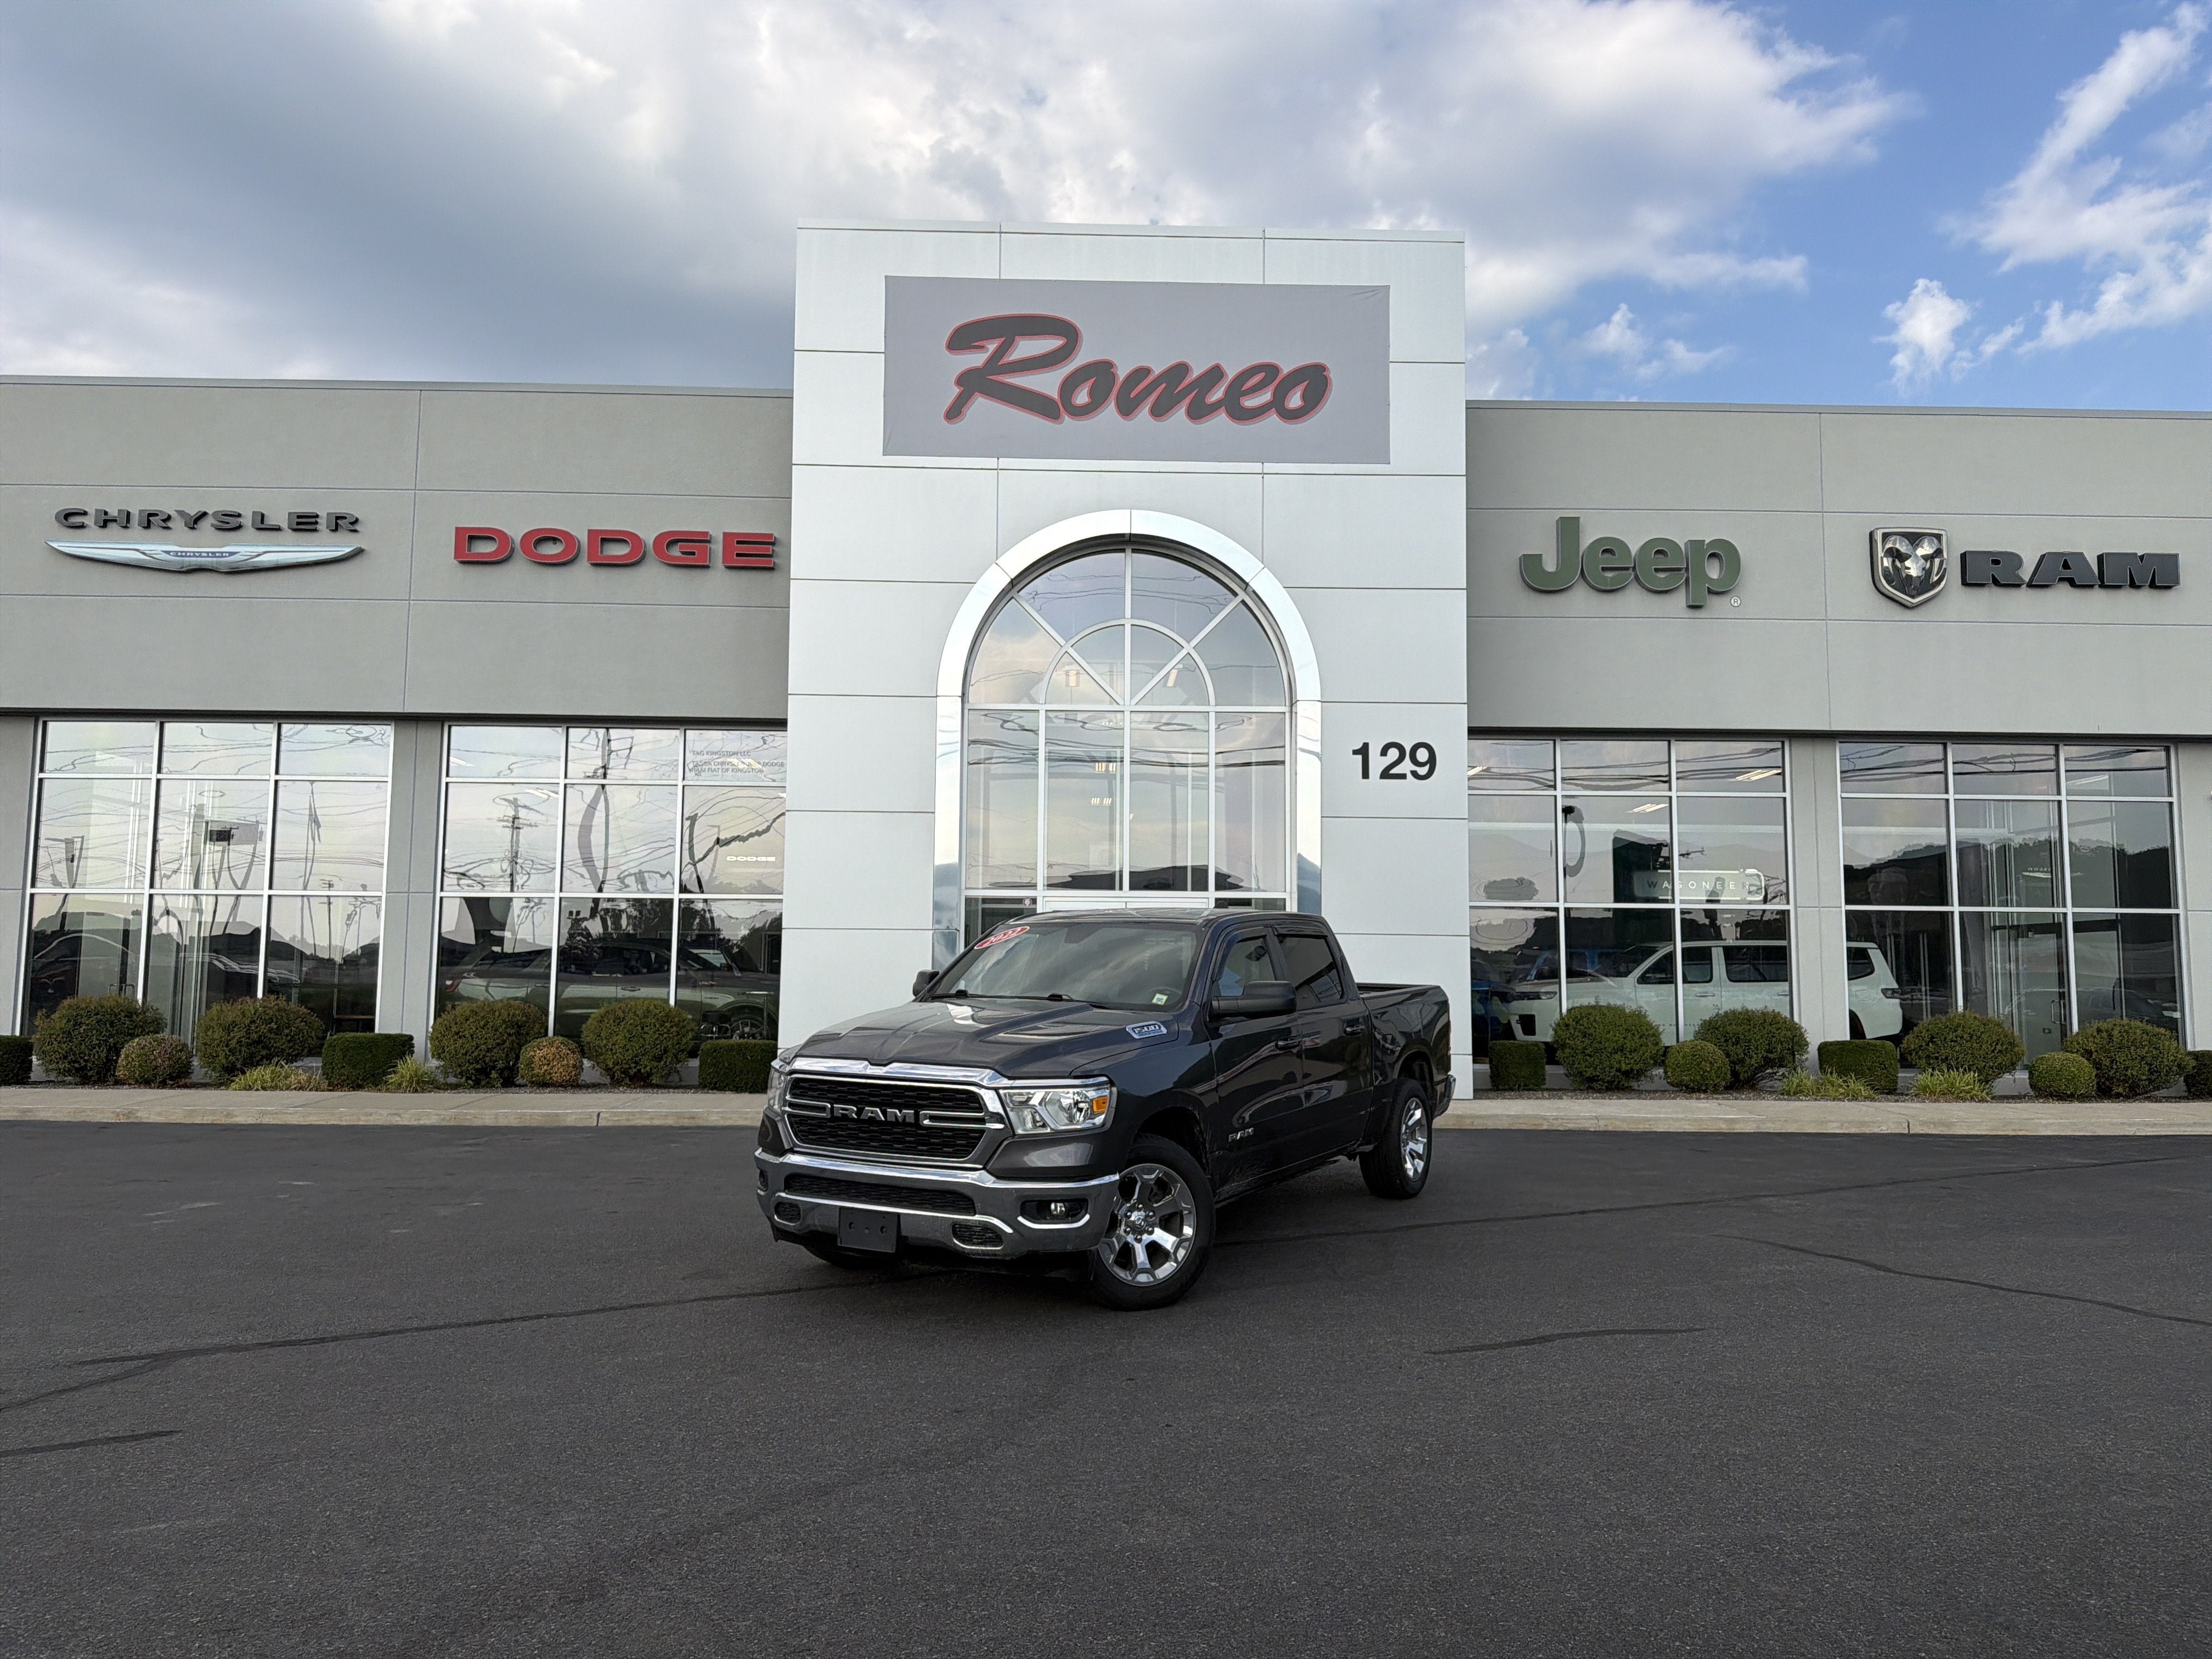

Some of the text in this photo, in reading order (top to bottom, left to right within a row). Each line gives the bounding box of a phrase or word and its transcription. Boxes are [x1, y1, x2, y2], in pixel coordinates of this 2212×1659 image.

[944, 313, 1332, 425] Romeo
[54, 507, 360, 533] CHRYSLER
[454, 526, 776, 568] DODGE
[1519, 516, 1741, 608] Jeep
[1960, 550, 2181, 587] RAM
[1352, 741, 1437, 781] 129
[982, 928, 1022, 947] 2022
[1132, 1024, 1159, 1034] 1500
[833, 1104, 915, 1124] RAM
[1228, 1127, 1254, 1142] RAM
